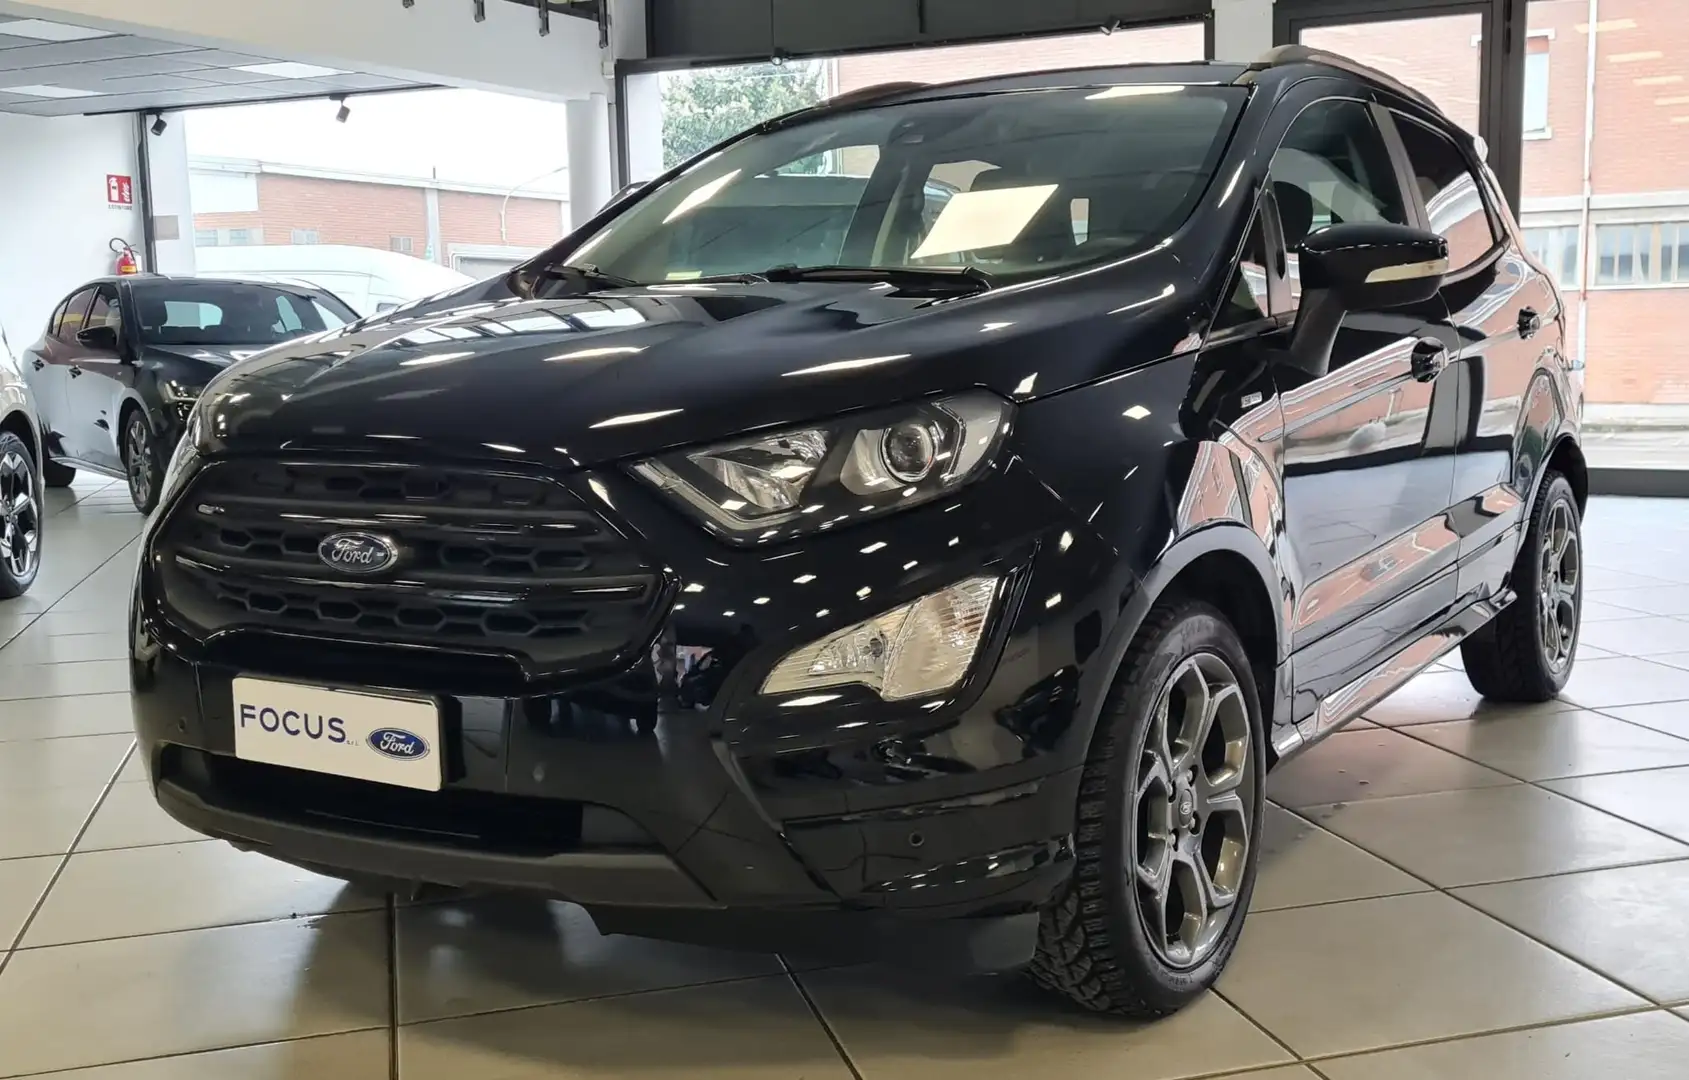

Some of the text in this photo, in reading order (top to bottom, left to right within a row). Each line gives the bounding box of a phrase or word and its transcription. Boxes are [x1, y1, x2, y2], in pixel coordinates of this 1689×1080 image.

[331, 538, 375, 564] Ford
[240, 703, 346, 743] FOCUS
[379, 731, 415, 755] Ford
